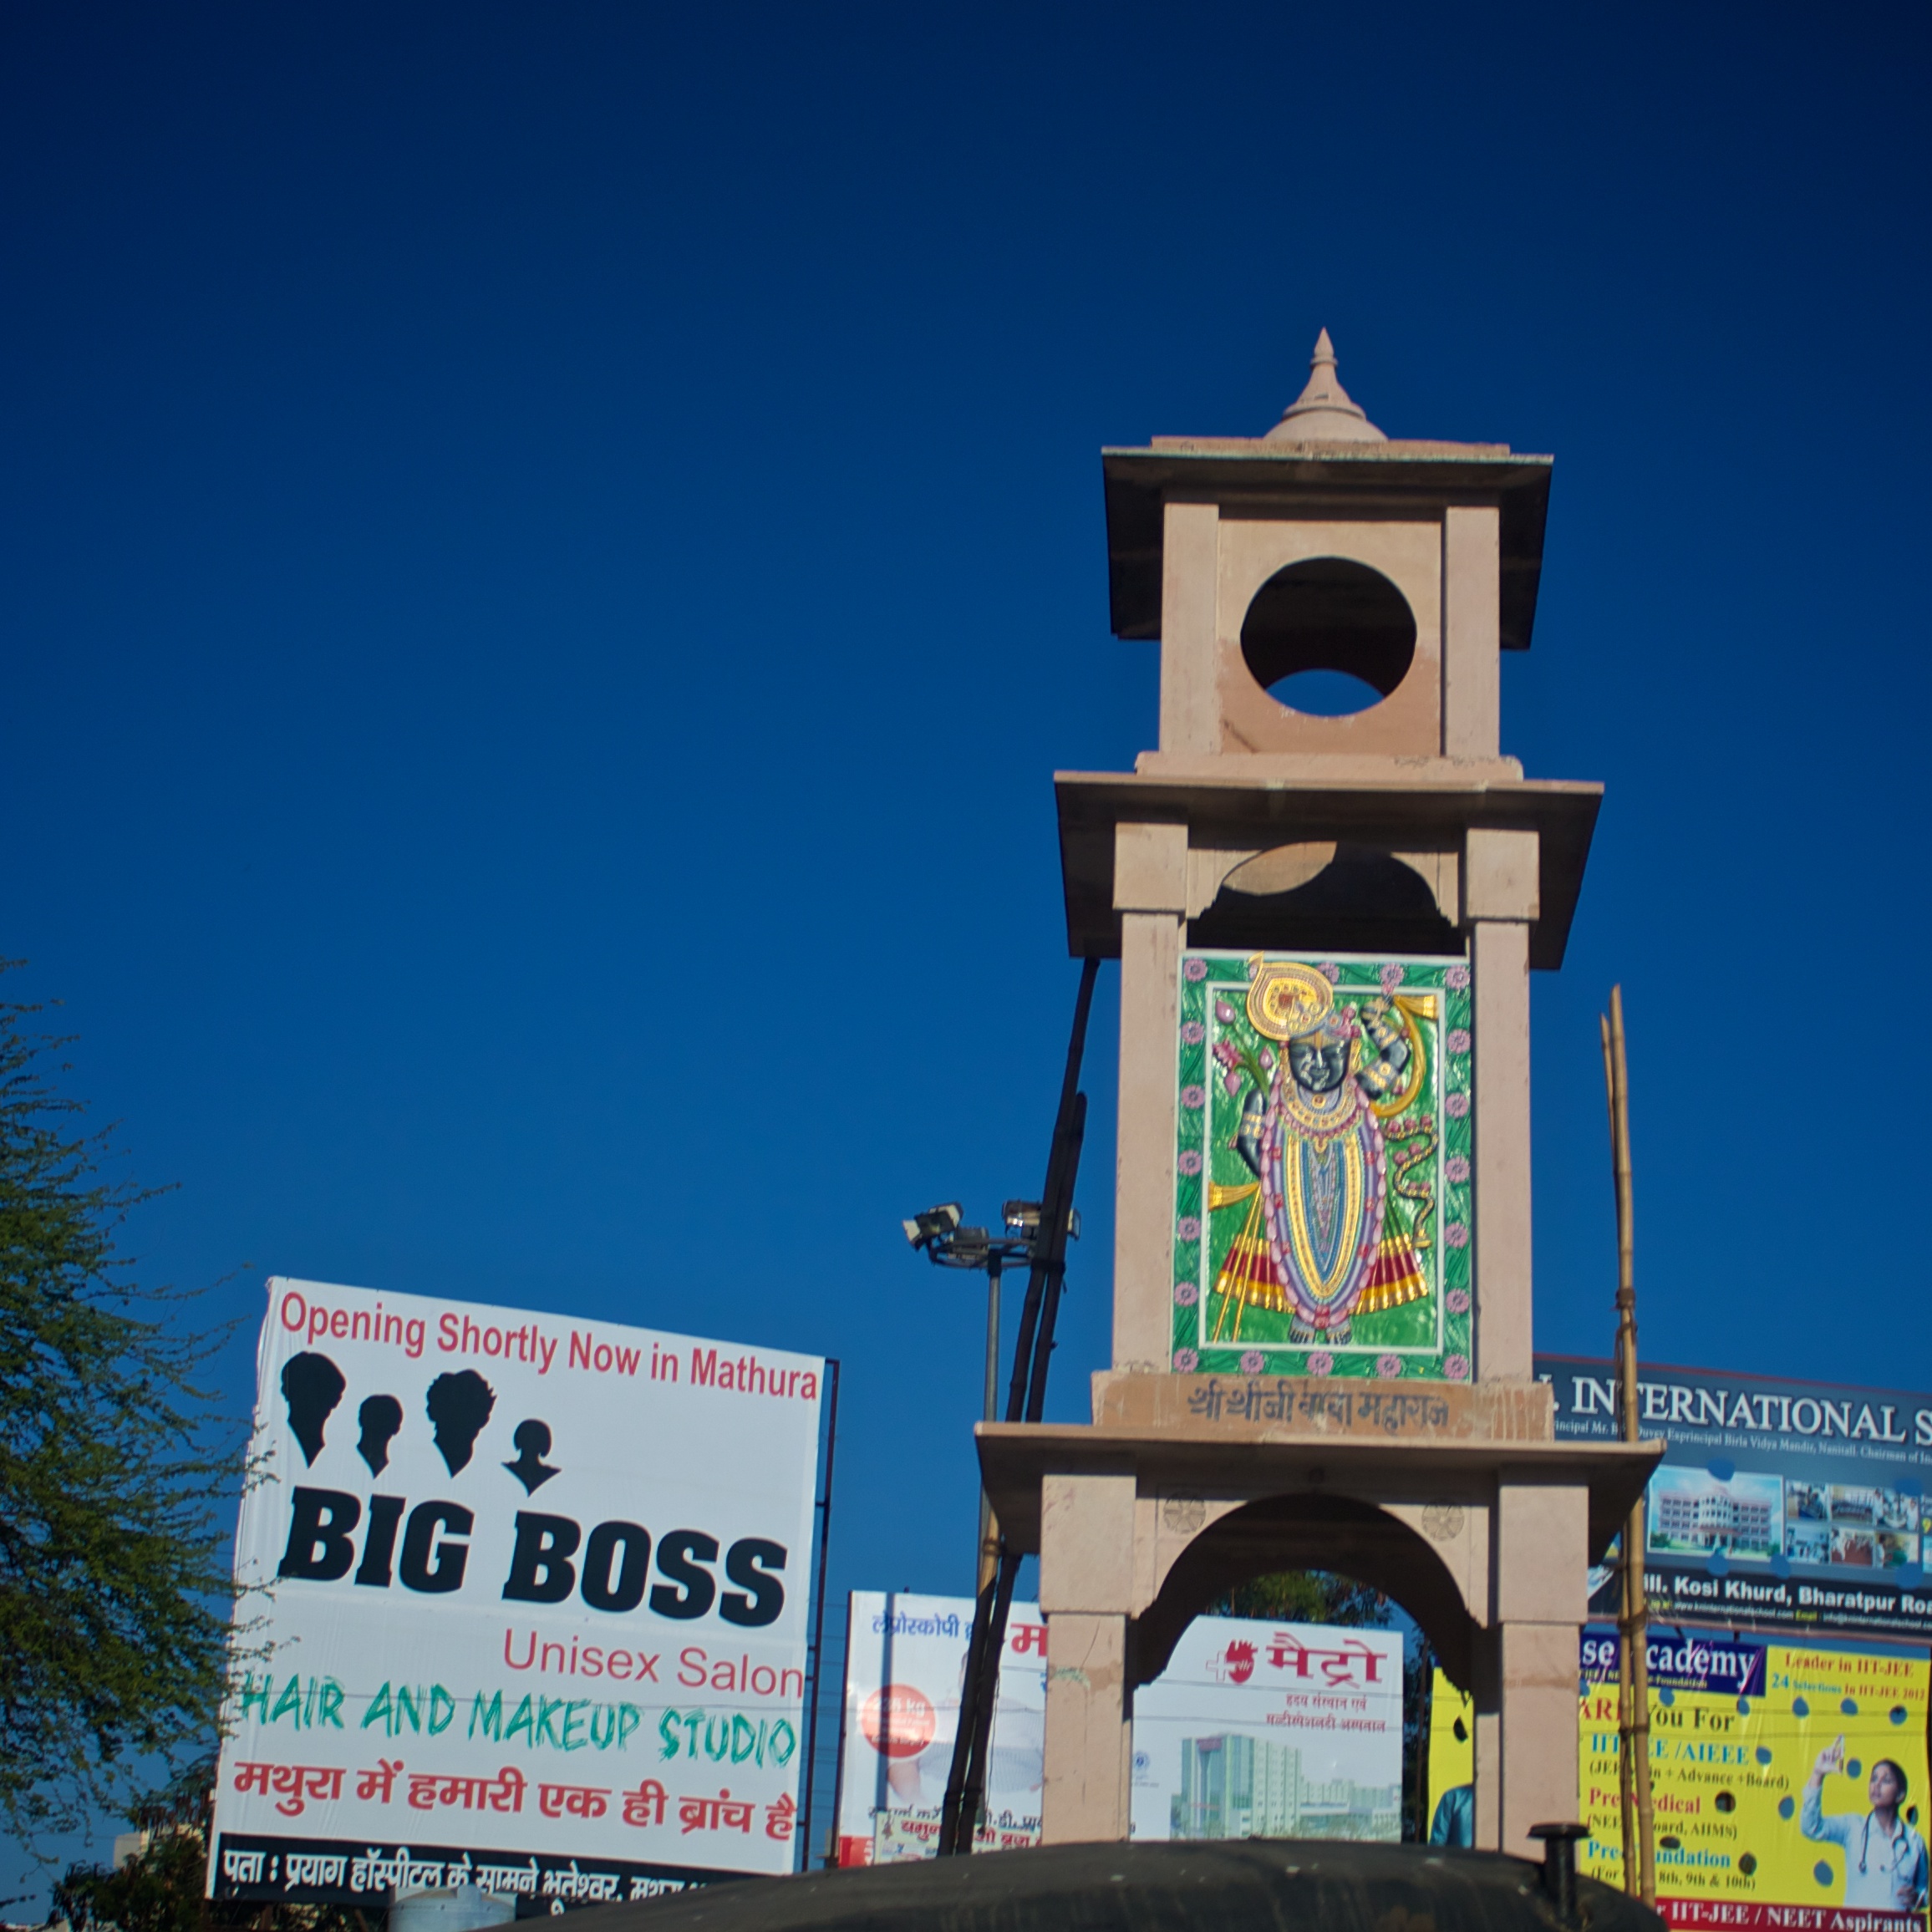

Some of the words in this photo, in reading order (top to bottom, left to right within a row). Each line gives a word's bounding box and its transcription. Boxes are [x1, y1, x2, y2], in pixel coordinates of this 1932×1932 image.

[280, 1292, 426, 1358] Opening
[437, 1313, 559, 1375] Shortly
[568, 1330, 642, 1376] Now
[651, 1343, 679, 1383] in
[690, 1348, 819, 1401] Mathura
[1555, 1418, 1589, 1436] incipal
[1571, 1376, 1907, 1444] INERNATIONAL
[278, 1485, 475, 1594] BIG
[501, 1510, 790, 1628] BOSS
[1644, 1574, 1668, 1594] ill.
[1674, 1575, 1719, 1598] Kosi
[1725, 1579, 1792, 1607] Khurd,
[1798, 1584, 1896, 1614] Bharatpur
[502, 1629, 661, 1684] Unisex
[678, 1648, 804, 1698] Salon
[1265, 1631, 1388, 1689] मैट्रो
[1645, 1638, 1755, 1689] cademy
[1772, 1672, 1789, 1690] 24
[240, 1671, 346, 1731] HAIR
[360, 1681, 455, 1738] AND
[468, 1690, 643, 1754] MAKEUP
[658, 1706, 796, 1769] STUDIO
[1694, 1706, 1736, 1732] For
[233, 1761, 346, 1817] मथुरा
[356, 1758, 404, 1803] में
[407, 1766, 528, 1813] हमारी
[538, 1782, 612, 1818] एक
[623, 1778, 669, 1827] ही
[679, 1789, 755, 1835] ब्रांच
[765, 1792, 797, 1841] है
[1677, 1767, 1733, 1786] Advance
[224, 1848, 267, 1884] पता
[285, 1853, 348, 1893] प्रयाग
[1671, 1901, 1749, 1924] IIT-JEE
[1767, 1907, 1827, 1930] NEET
